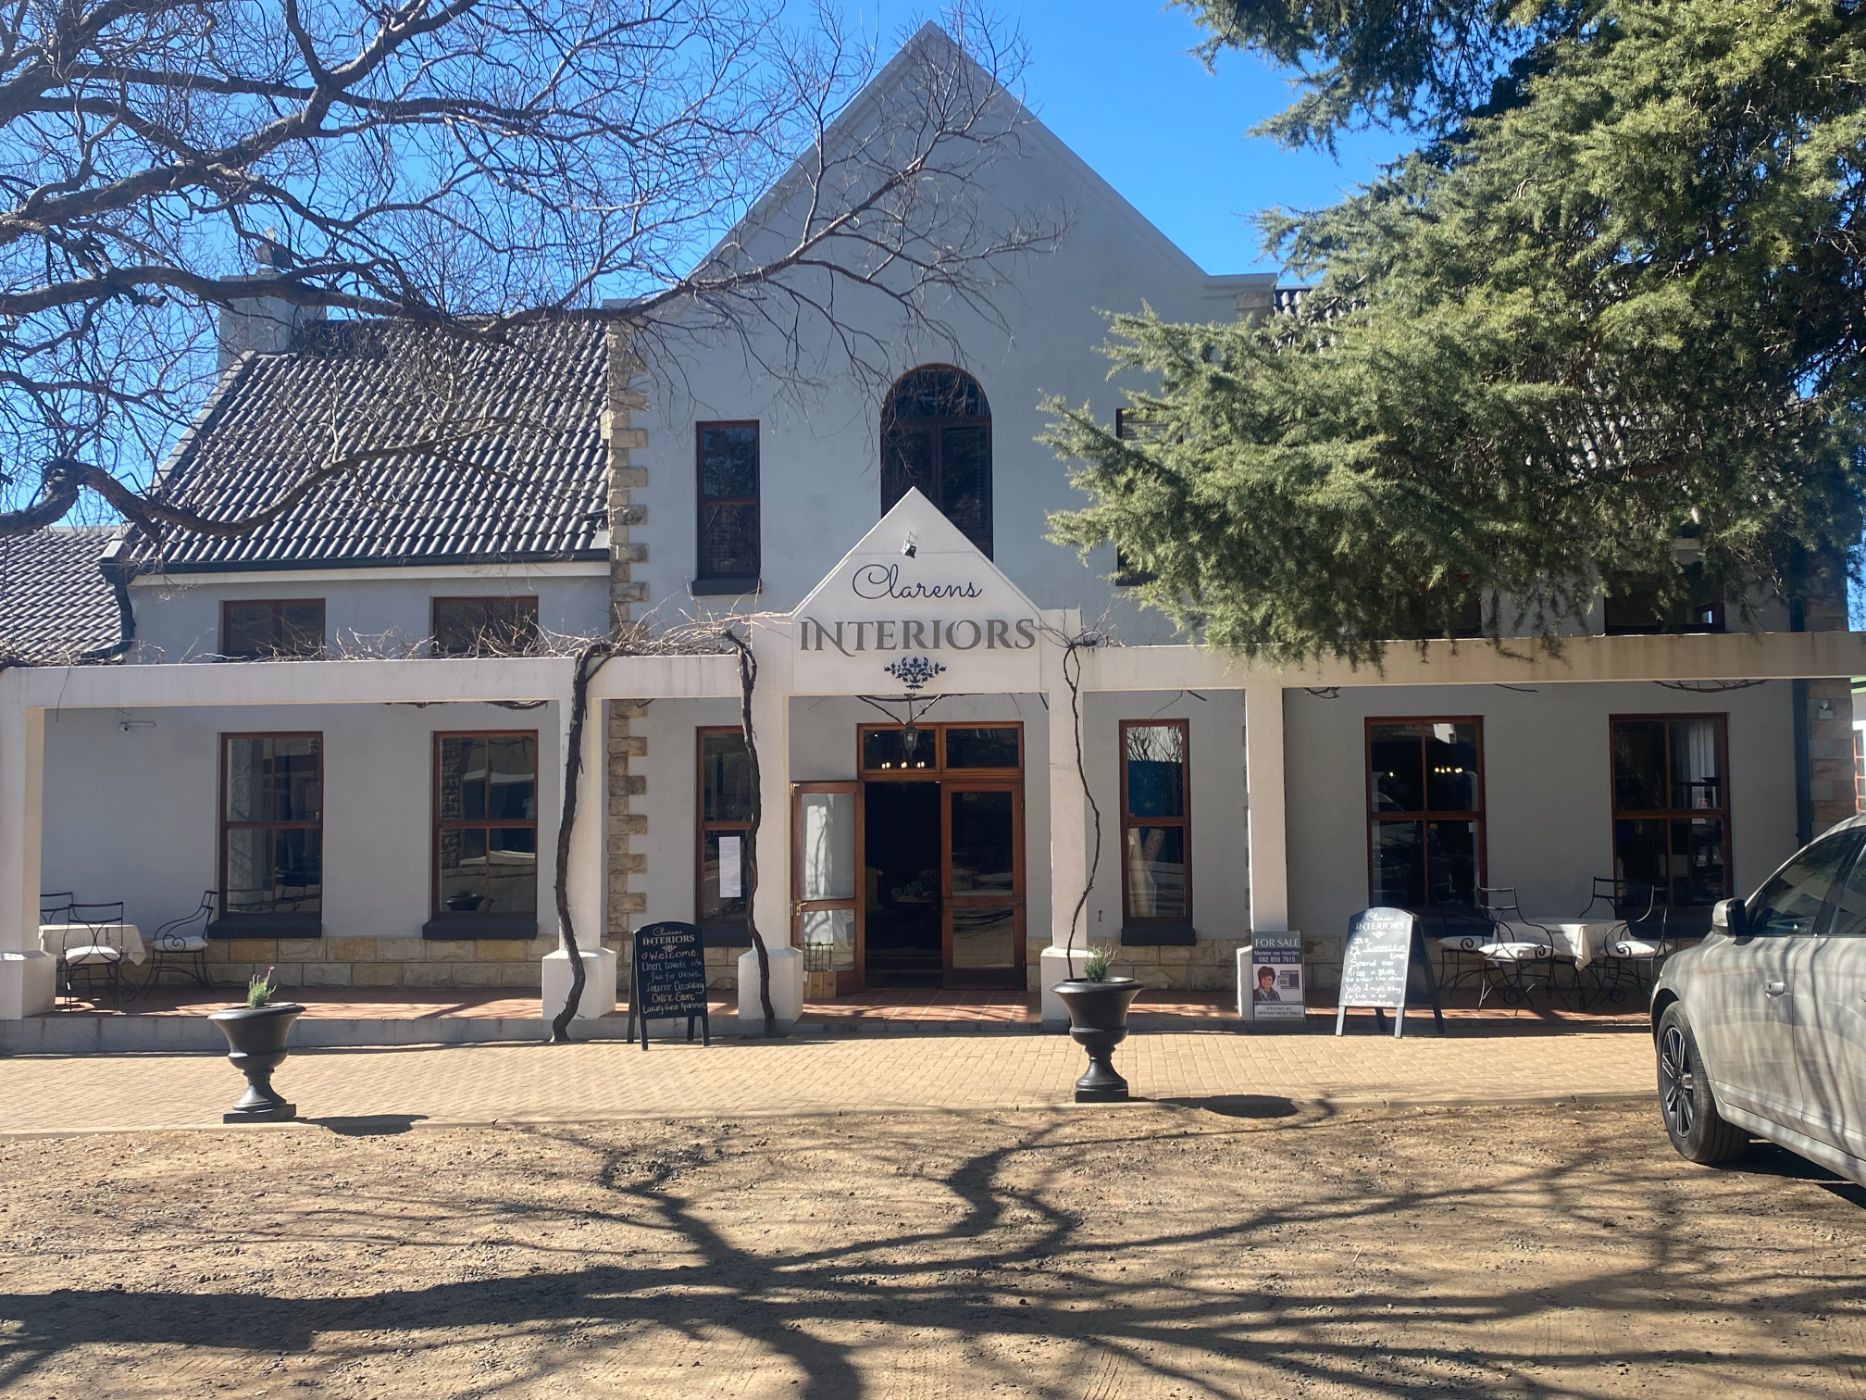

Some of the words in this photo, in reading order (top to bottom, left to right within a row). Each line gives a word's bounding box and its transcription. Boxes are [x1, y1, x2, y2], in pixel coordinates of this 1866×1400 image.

[852, 564, 982, 599] Clarens
[800, 616, 1036, 657] INTERIORS
[1355, 921, 1404, 931] INTERIORS
[642, 935, 695, 945] INTERIORS
[1255, 938, 1275, 947] FOR
[1277, 938, 1299, 947] SALE
[642, 961, 662, 972] Linen
[664, 959, 686, 970] towels
[1350, 960, 1377, 969] Spend
[646, 982, 672, 992] Interior
[674, 981, 705, 994] Decorating
[1345, 982, 1361, 993] Win
[651, 993, 674, 1003] Online
[675, 991, 695, 1002] Store
[642, 1004, 664, 1015] Luxury
